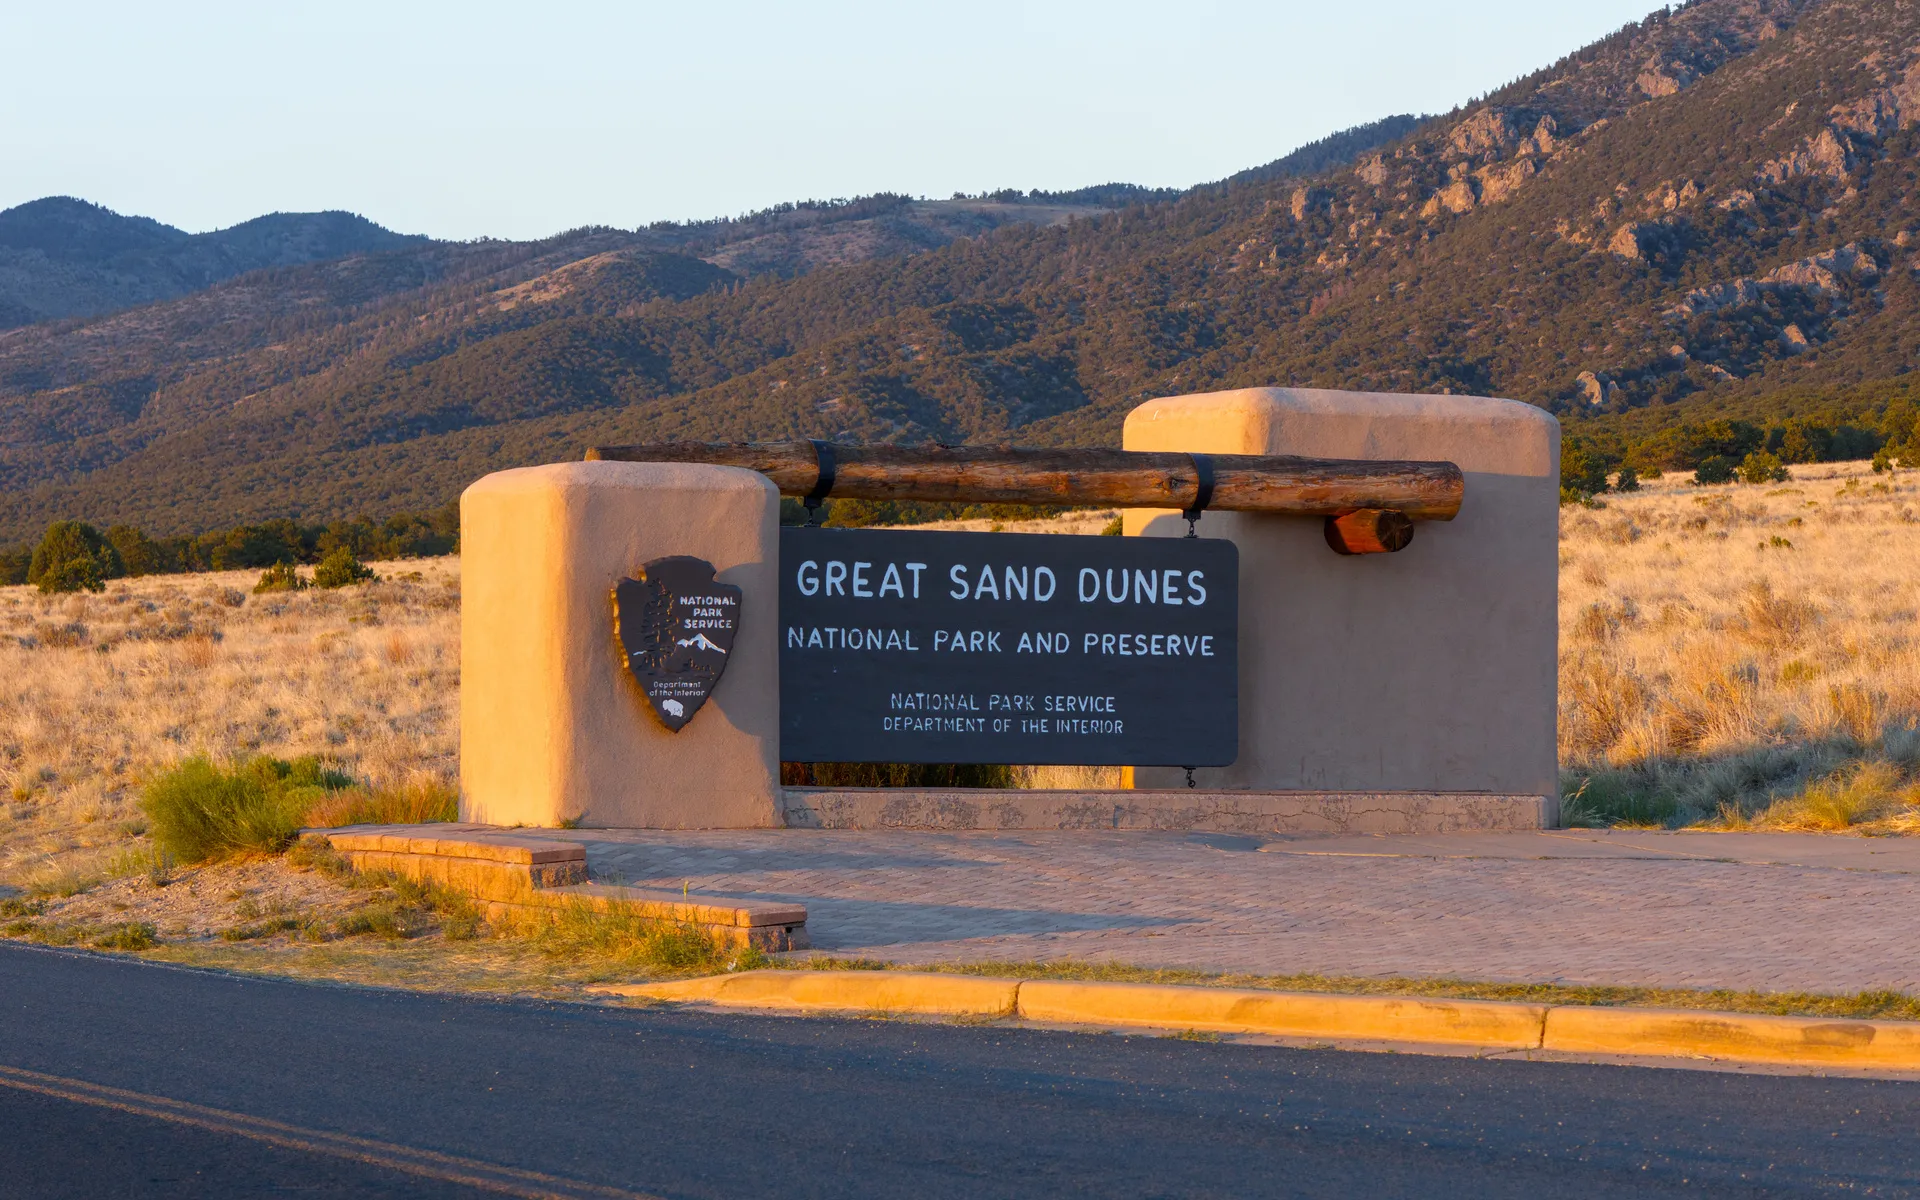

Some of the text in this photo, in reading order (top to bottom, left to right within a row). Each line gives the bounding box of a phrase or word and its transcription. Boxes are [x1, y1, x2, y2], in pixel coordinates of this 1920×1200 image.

[797, 560, 1207, 606] GREAT SAND DUNES
[680, 596, 736, 606] NATIONAL
[693, 607, 723, 617] PARK
[683, 618, 732, 629] SERVICE
[788, 627, 1214, 656] NATIONAL PARK AND PRESERVE
[653, 680, 701, 689] Department
[649, 688, 705, 697] of the Interior
[891, 692, 1116, 713] NATIONAL PARK SERVICE
[883, 716, 1124, 734] DEPARTMENT OF THE INTERIOR
